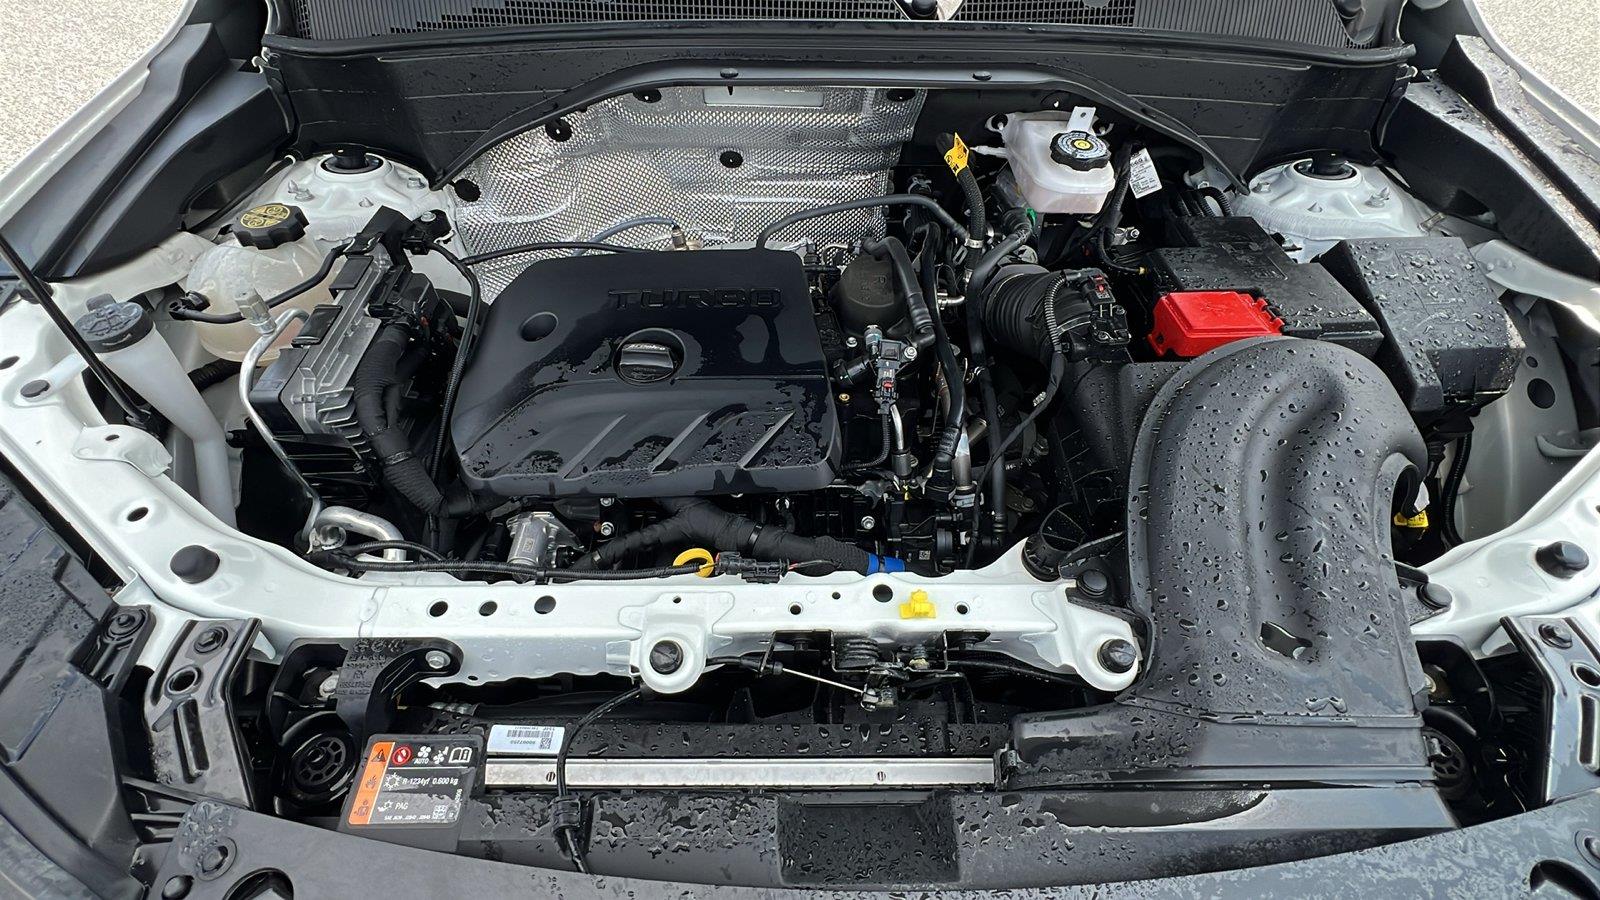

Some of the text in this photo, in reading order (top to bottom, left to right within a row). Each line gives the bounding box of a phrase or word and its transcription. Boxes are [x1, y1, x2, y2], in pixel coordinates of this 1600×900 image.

[608, 287, 782, 309] TURBO
[402, 777, 459, 786] R-1234yf 0.600 kg
[395, 802, 409, 810] PAG
